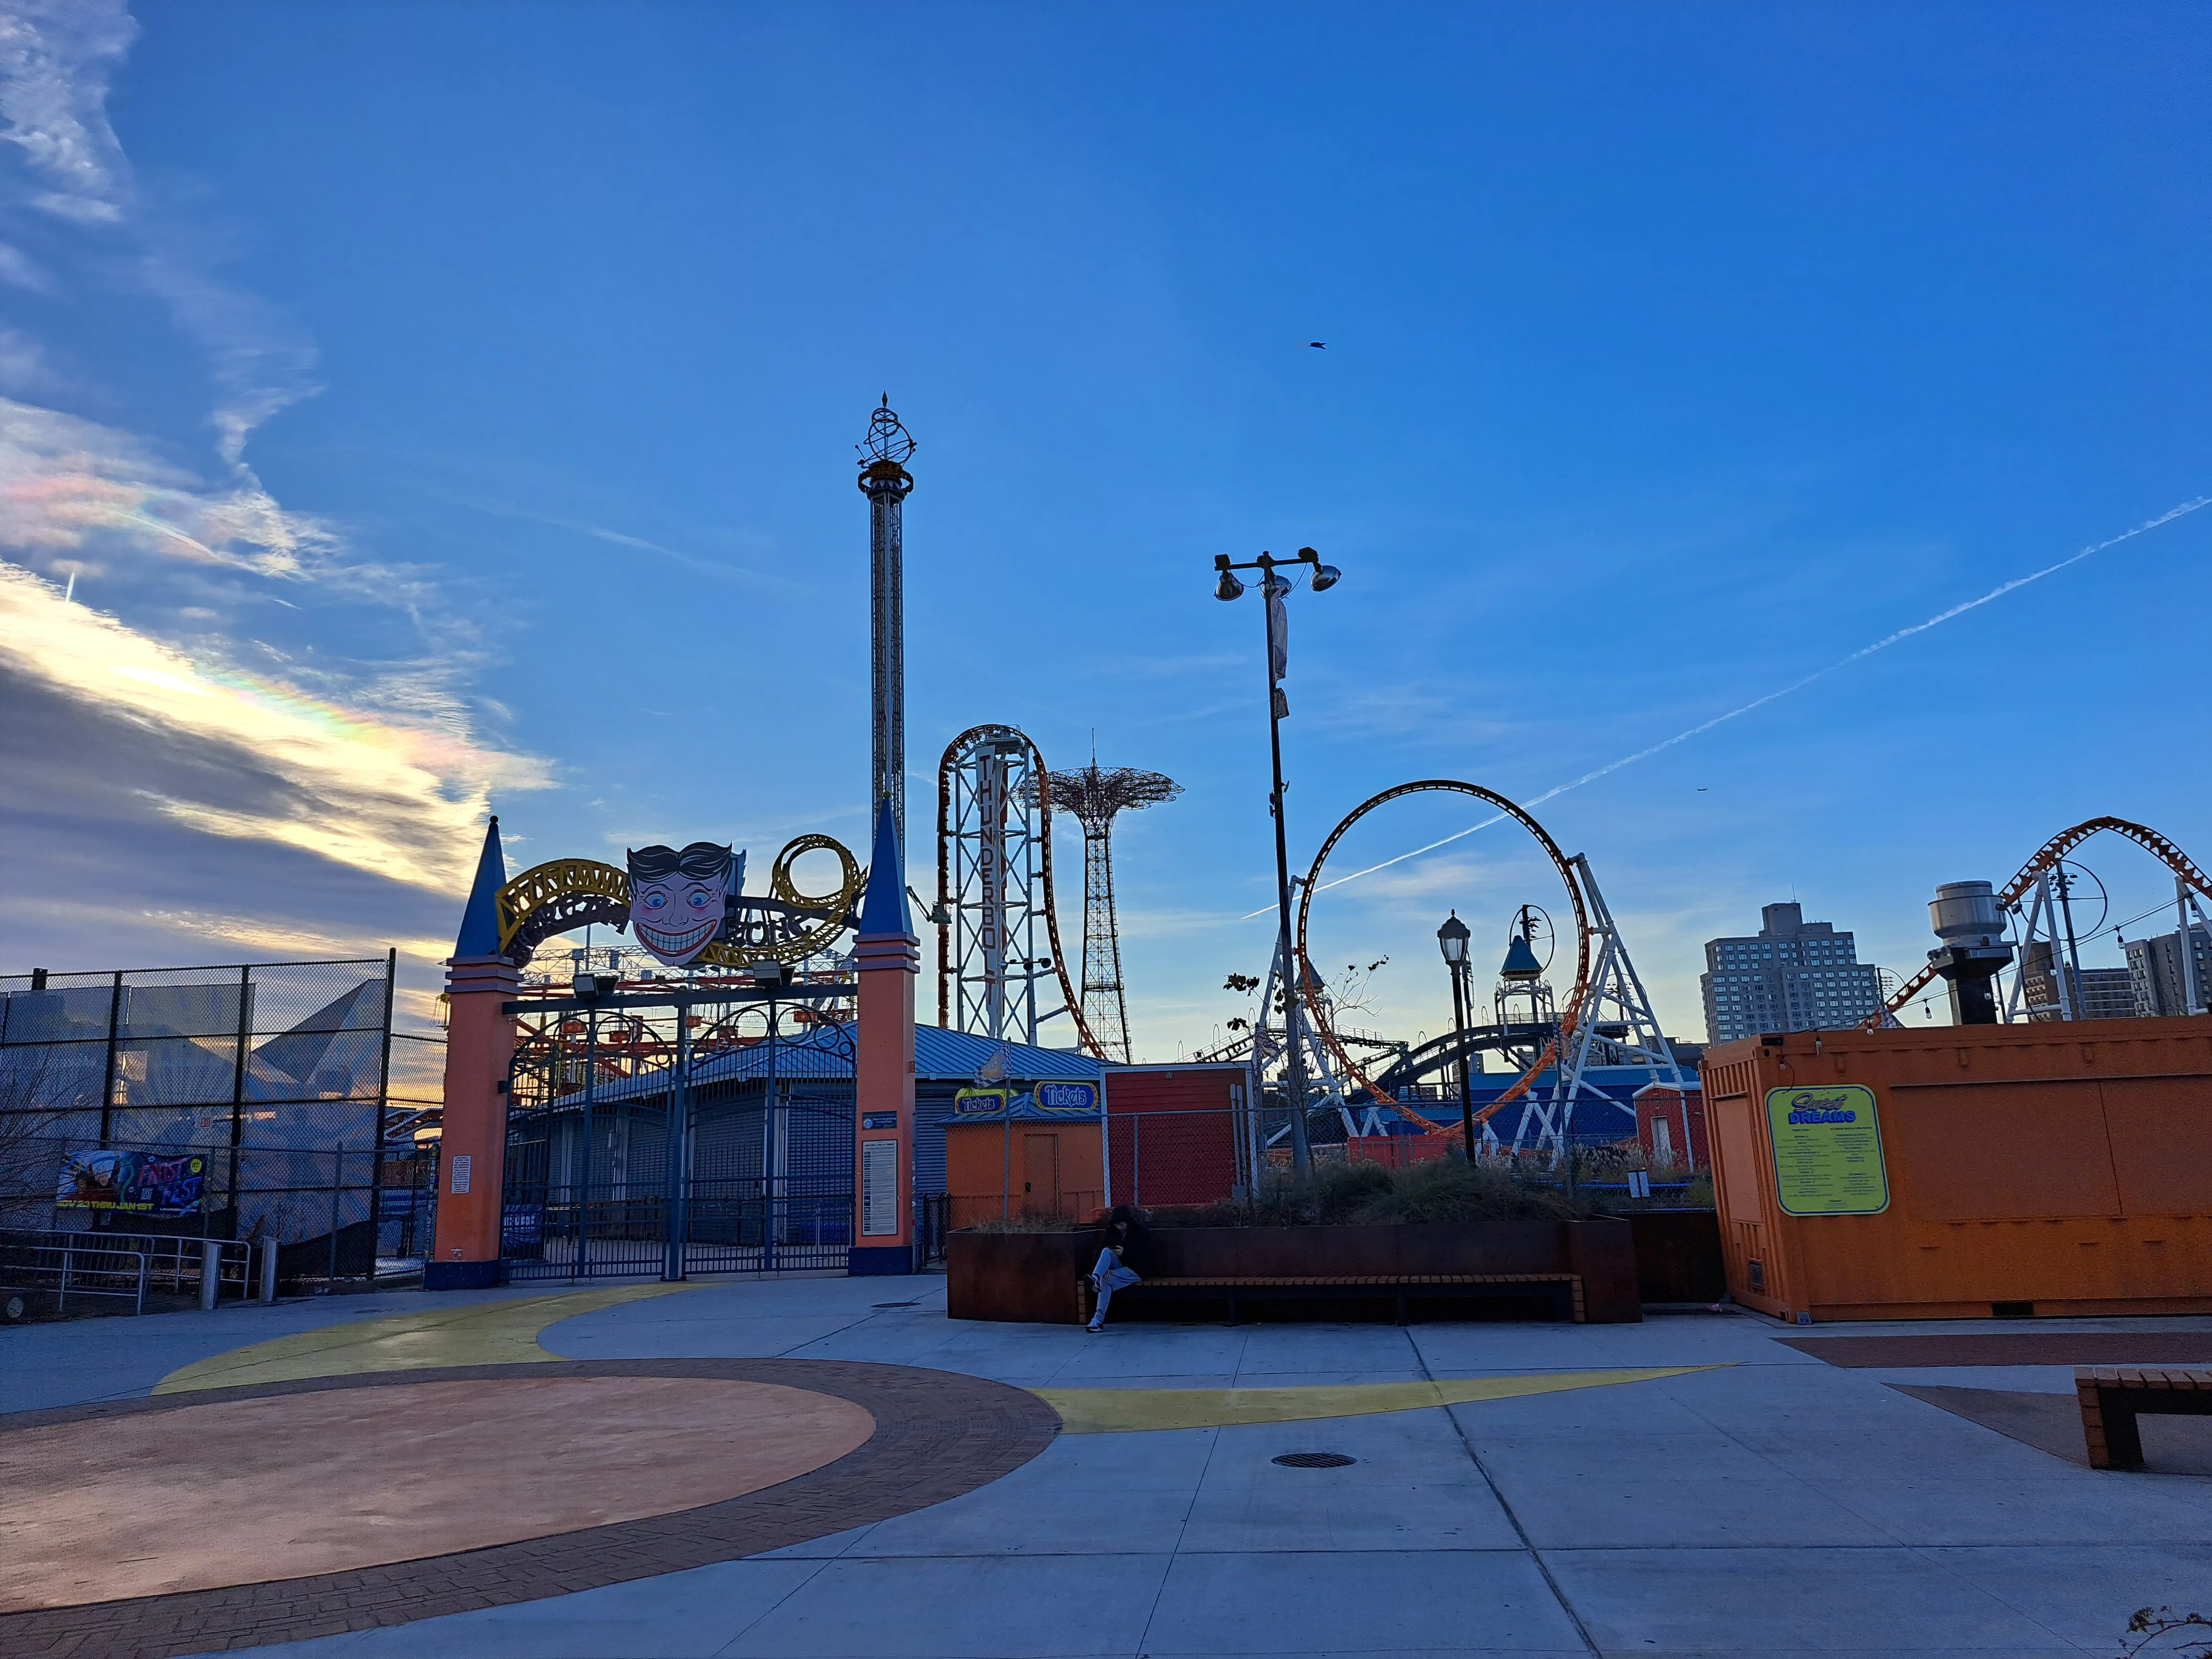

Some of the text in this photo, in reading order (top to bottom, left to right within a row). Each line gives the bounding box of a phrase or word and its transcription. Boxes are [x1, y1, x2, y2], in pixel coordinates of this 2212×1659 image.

[979, 754, 996, 1005] THUNDERBOLT
[962, 1097, 995, 1112] Tickets
[1045, 1084, 1086, 1107] Tickets
[1791, 1093, 1847, 1112] Sweet
[200, 1117, 211, 1127] EXIT
[1788, 1110, 1856, 1124] DREAMS
[137, 1157, 188, 1187] FROST
[161, 1176, 203, 1206] FEST
[116, 1202, 136, 1211] JAN
